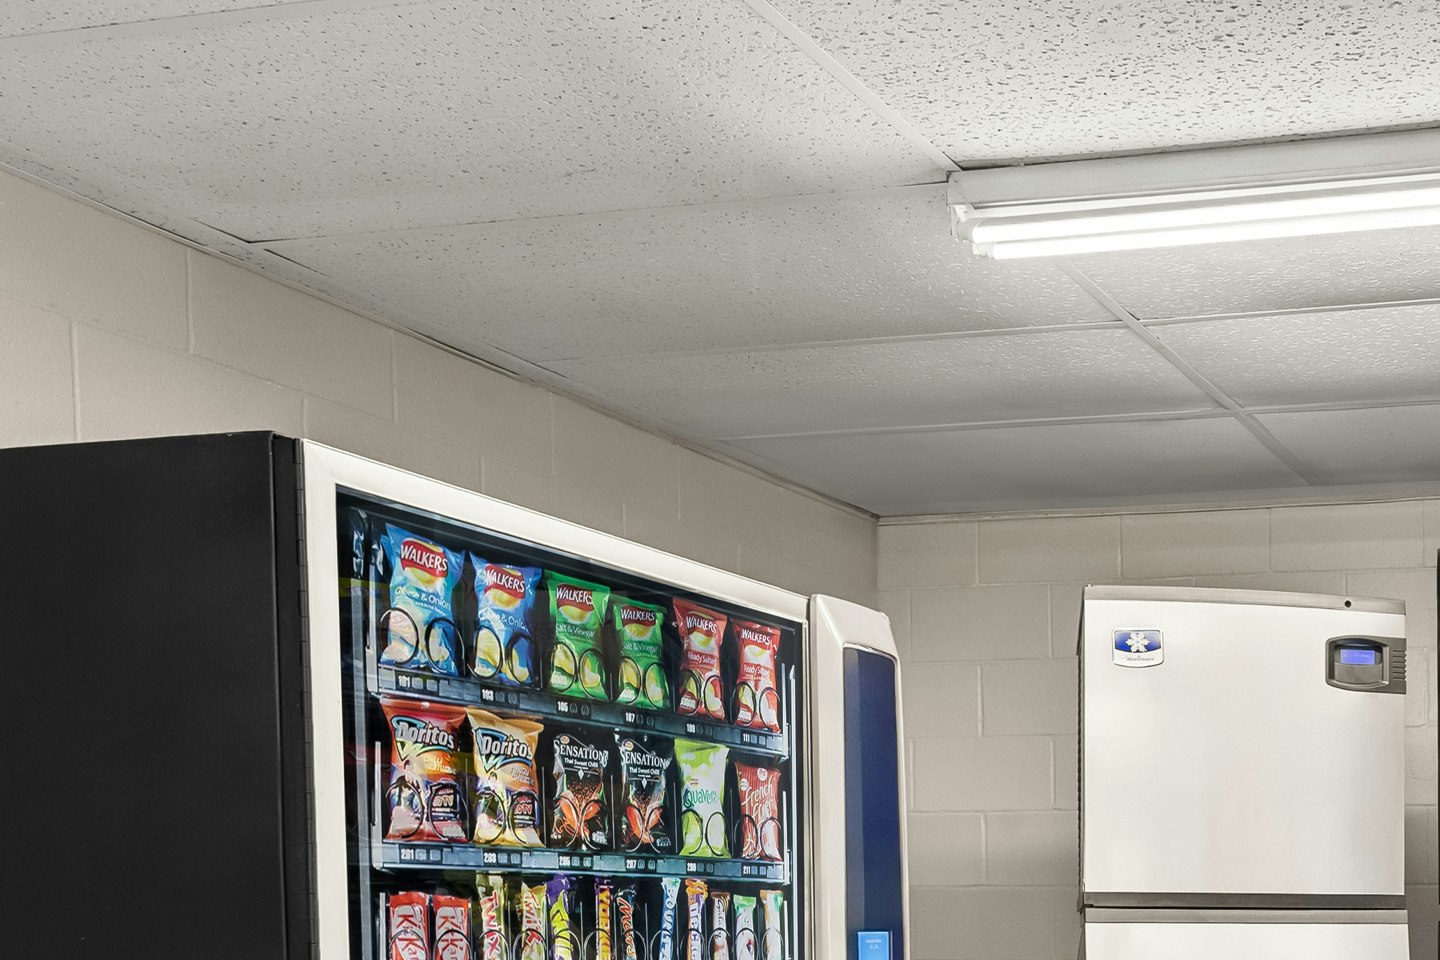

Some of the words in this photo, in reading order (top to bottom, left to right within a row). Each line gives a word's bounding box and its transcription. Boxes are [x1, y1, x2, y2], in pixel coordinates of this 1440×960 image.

[400, 545, 448, 572] WALKERS
[484, 569, 526, 593] WALKERS
[428, 594, 451, 611] Onion
[620, 608, 655, 621] WALKERS
[686, 616, 717, 634] WALKERS
[741, 629, 771, 645] WALKERS
[399, 722, 454, 749] Doritos
[481, 735, 533, 759] Doritos
[617, 896, 636, 957] Mars
